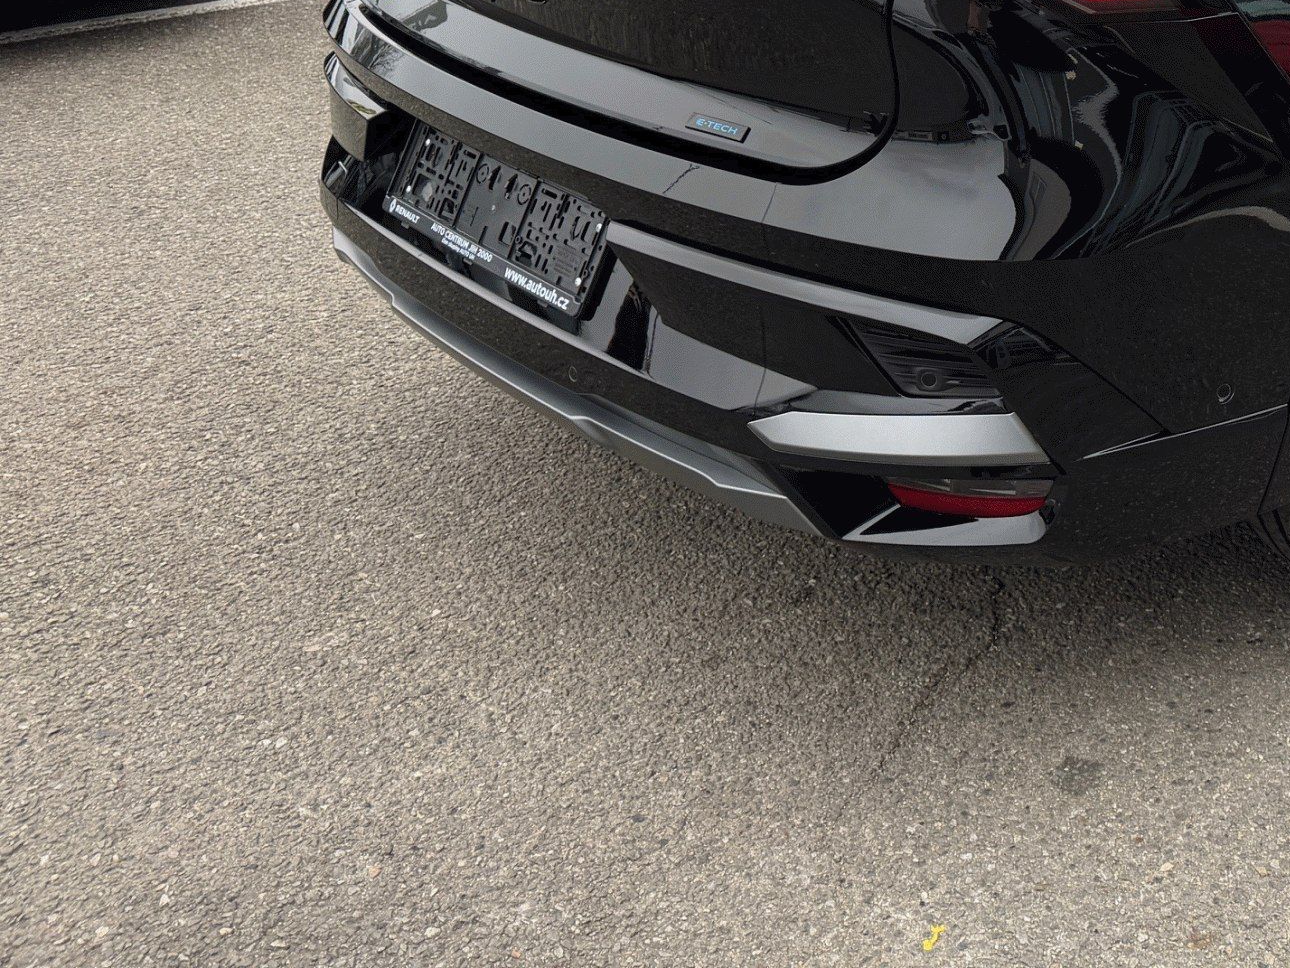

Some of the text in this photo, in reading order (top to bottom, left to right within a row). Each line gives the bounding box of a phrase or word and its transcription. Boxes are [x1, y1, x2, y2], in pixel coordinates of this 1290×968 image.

[395, 204, 420, 224] RENAULT
[430, 222, 445, 237] AUTO
[443, 228, 470, 250] CENTRUM
[477, 245, 493, 263] 2000
[504, 267, 571, 311] www.autouh.cz
